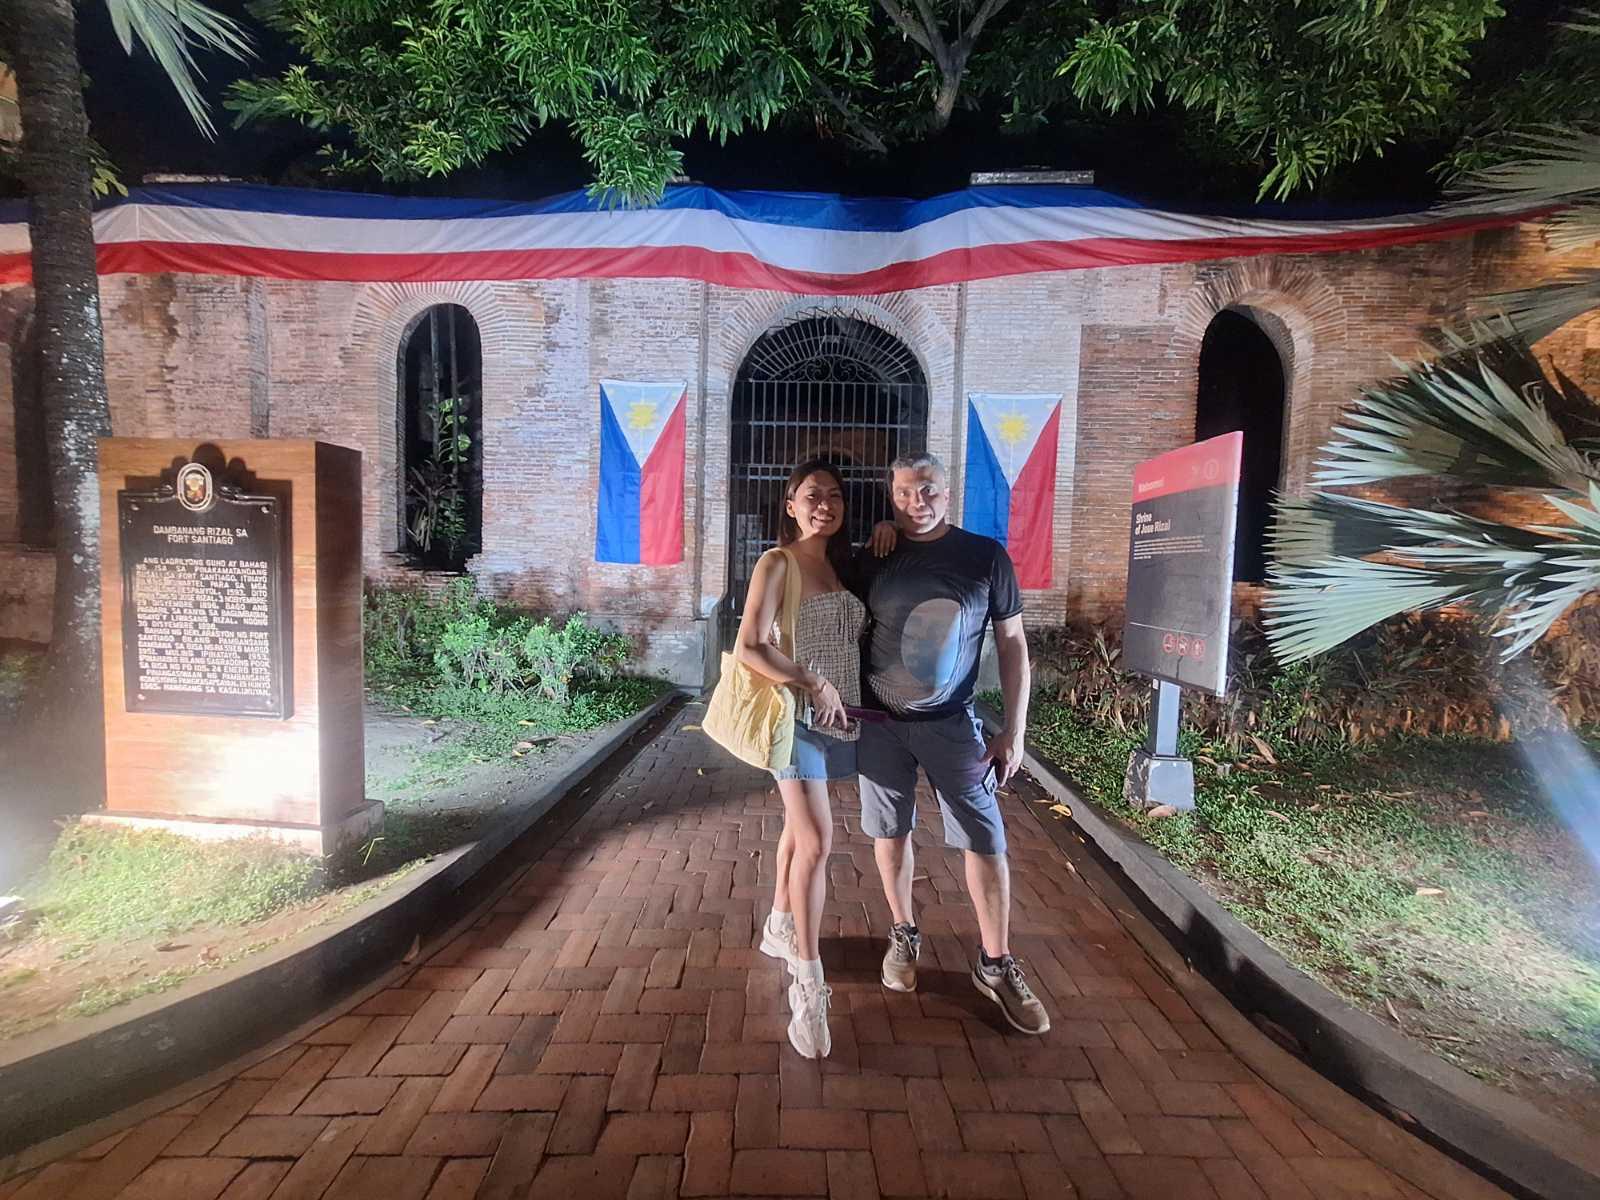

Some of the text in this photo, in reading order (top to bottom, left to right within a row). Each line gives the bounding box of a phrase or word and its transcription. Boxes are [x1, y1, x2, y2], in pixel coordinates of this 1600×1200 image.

[1136, 512, 1152, 524] Shrine
[153, 525, 248, 537] DAMBANANG RIZAL SA
[1134, 519, 1170, 535] of Jose Rizal
[168, 535, 233, 544] FORT SANTIAGO
[239, 561, 267, 569] BAHAGI
[226, 602, 245, 610] BAGO
